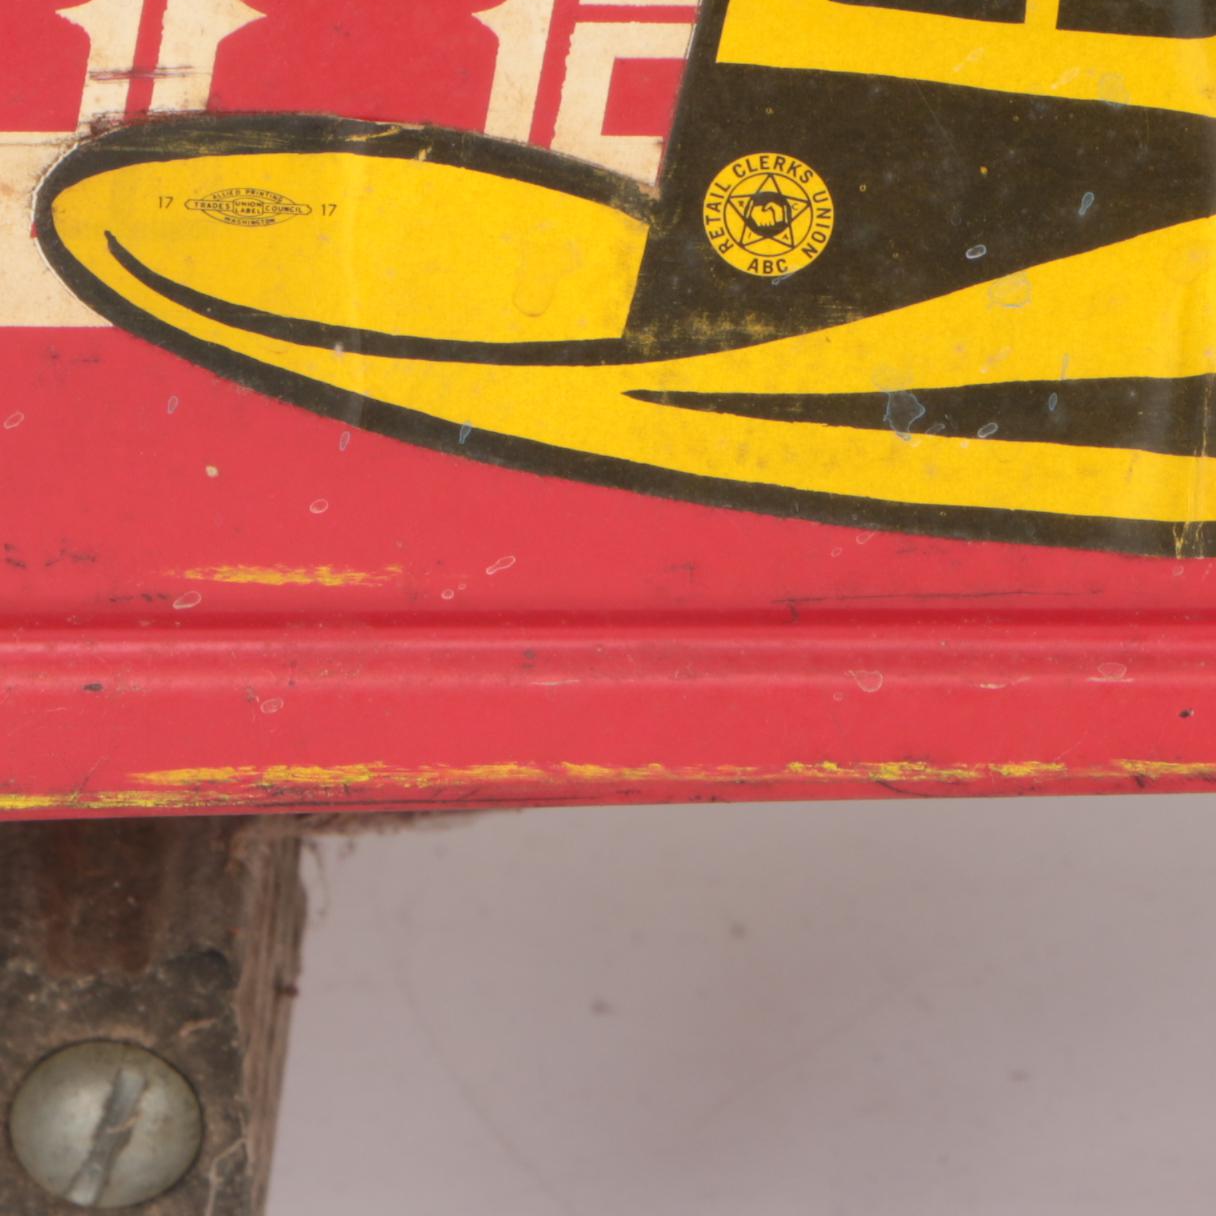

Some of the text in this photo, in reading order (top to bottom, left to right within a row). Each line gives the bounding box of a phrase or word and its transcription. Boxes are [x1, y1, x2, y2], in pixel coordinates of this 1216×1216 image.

[158, 195, 174, 209] 17
[212, 188, 284, 203] ALLIED PRINTING
[194, 201, 303, 214] TRADES COUNCIL
[320, 203, 338, 217] 17
[705, 155, 832, 259] RETAIL CLERKS UNION
[746, 257, 788, 275] ABC
